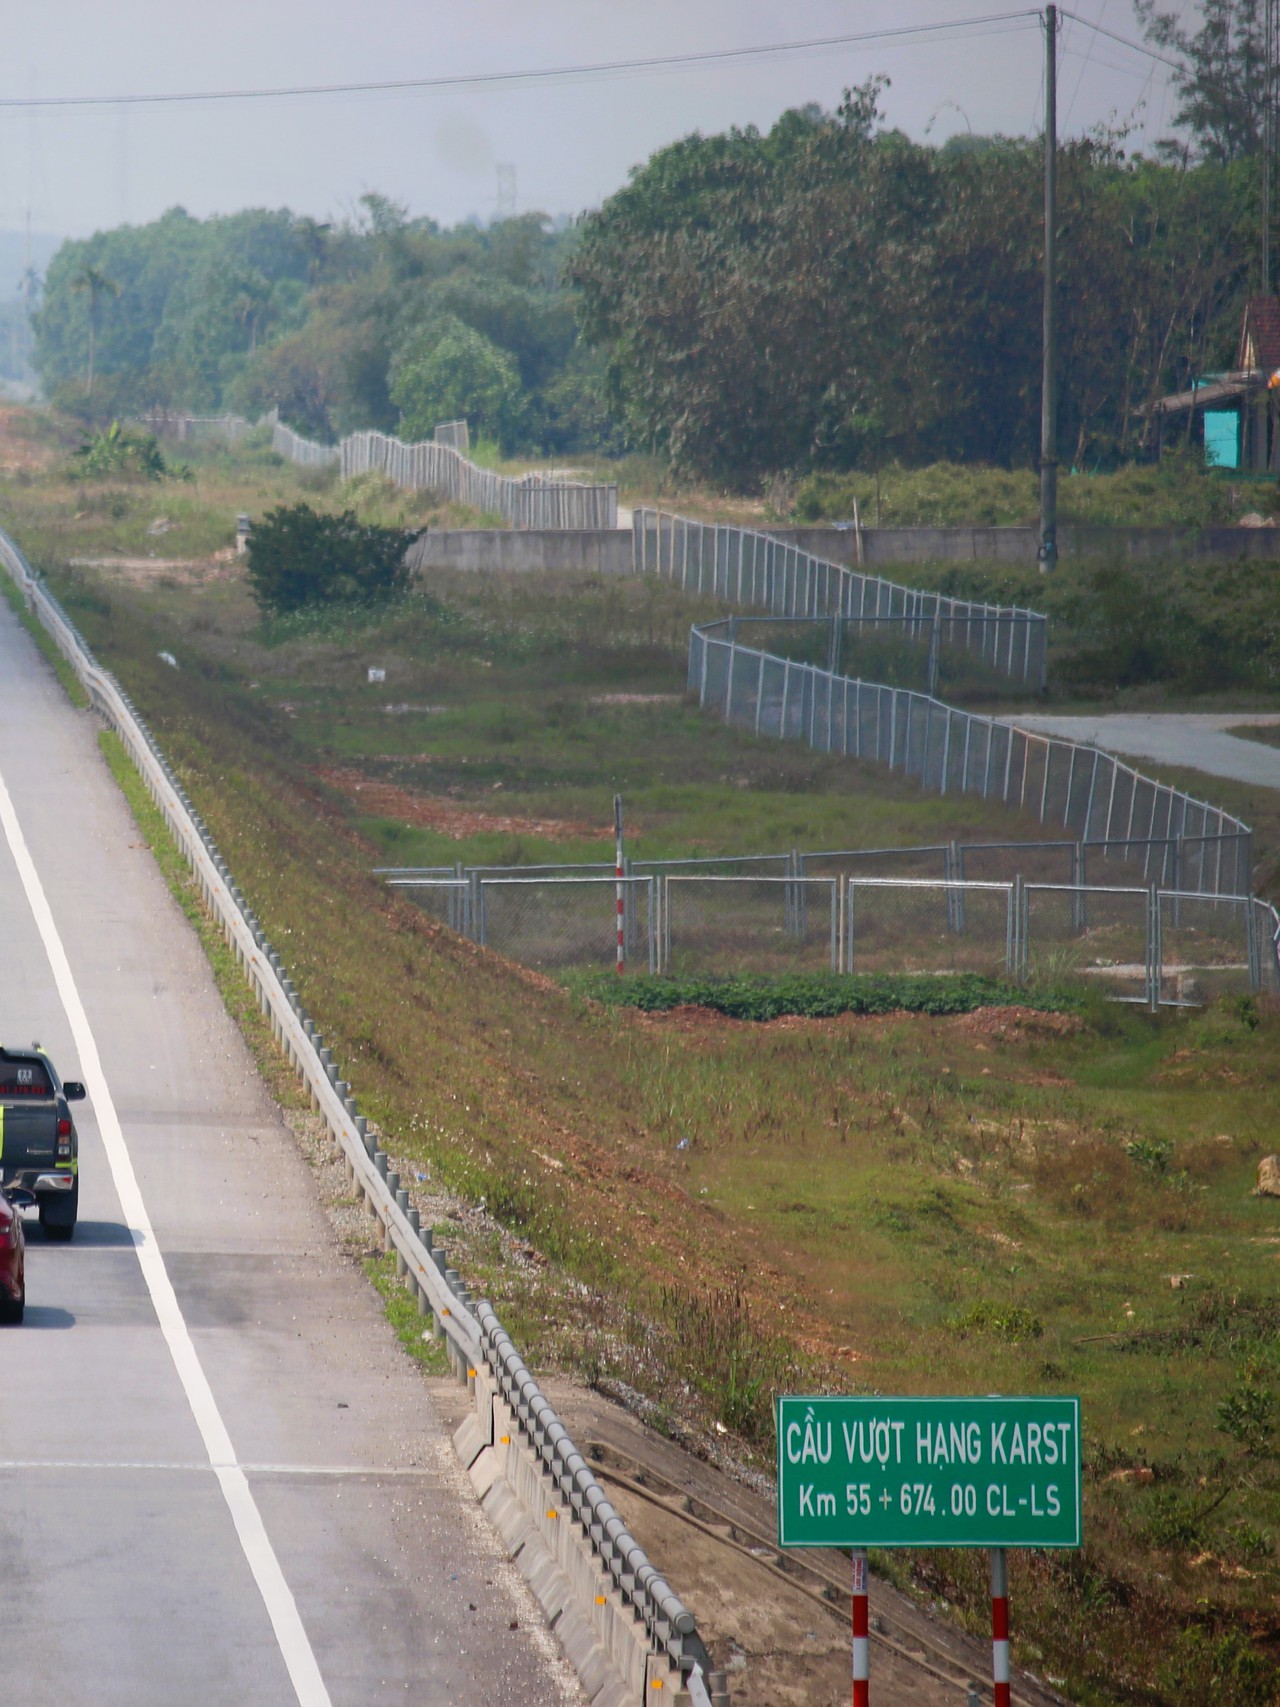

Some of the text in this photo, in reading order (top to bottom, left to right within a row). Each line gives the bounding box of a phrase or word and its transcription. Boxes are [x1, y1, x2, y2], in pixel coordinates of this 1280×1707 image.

[787, 1407, 1071, 1471] CẦU VƯỢT HẠNG KARST
[799, 1484, 836, 1517] Km
[846, 1484, 870, 1516] 55
[986, 1484, 1061, 1517] CL-LS
